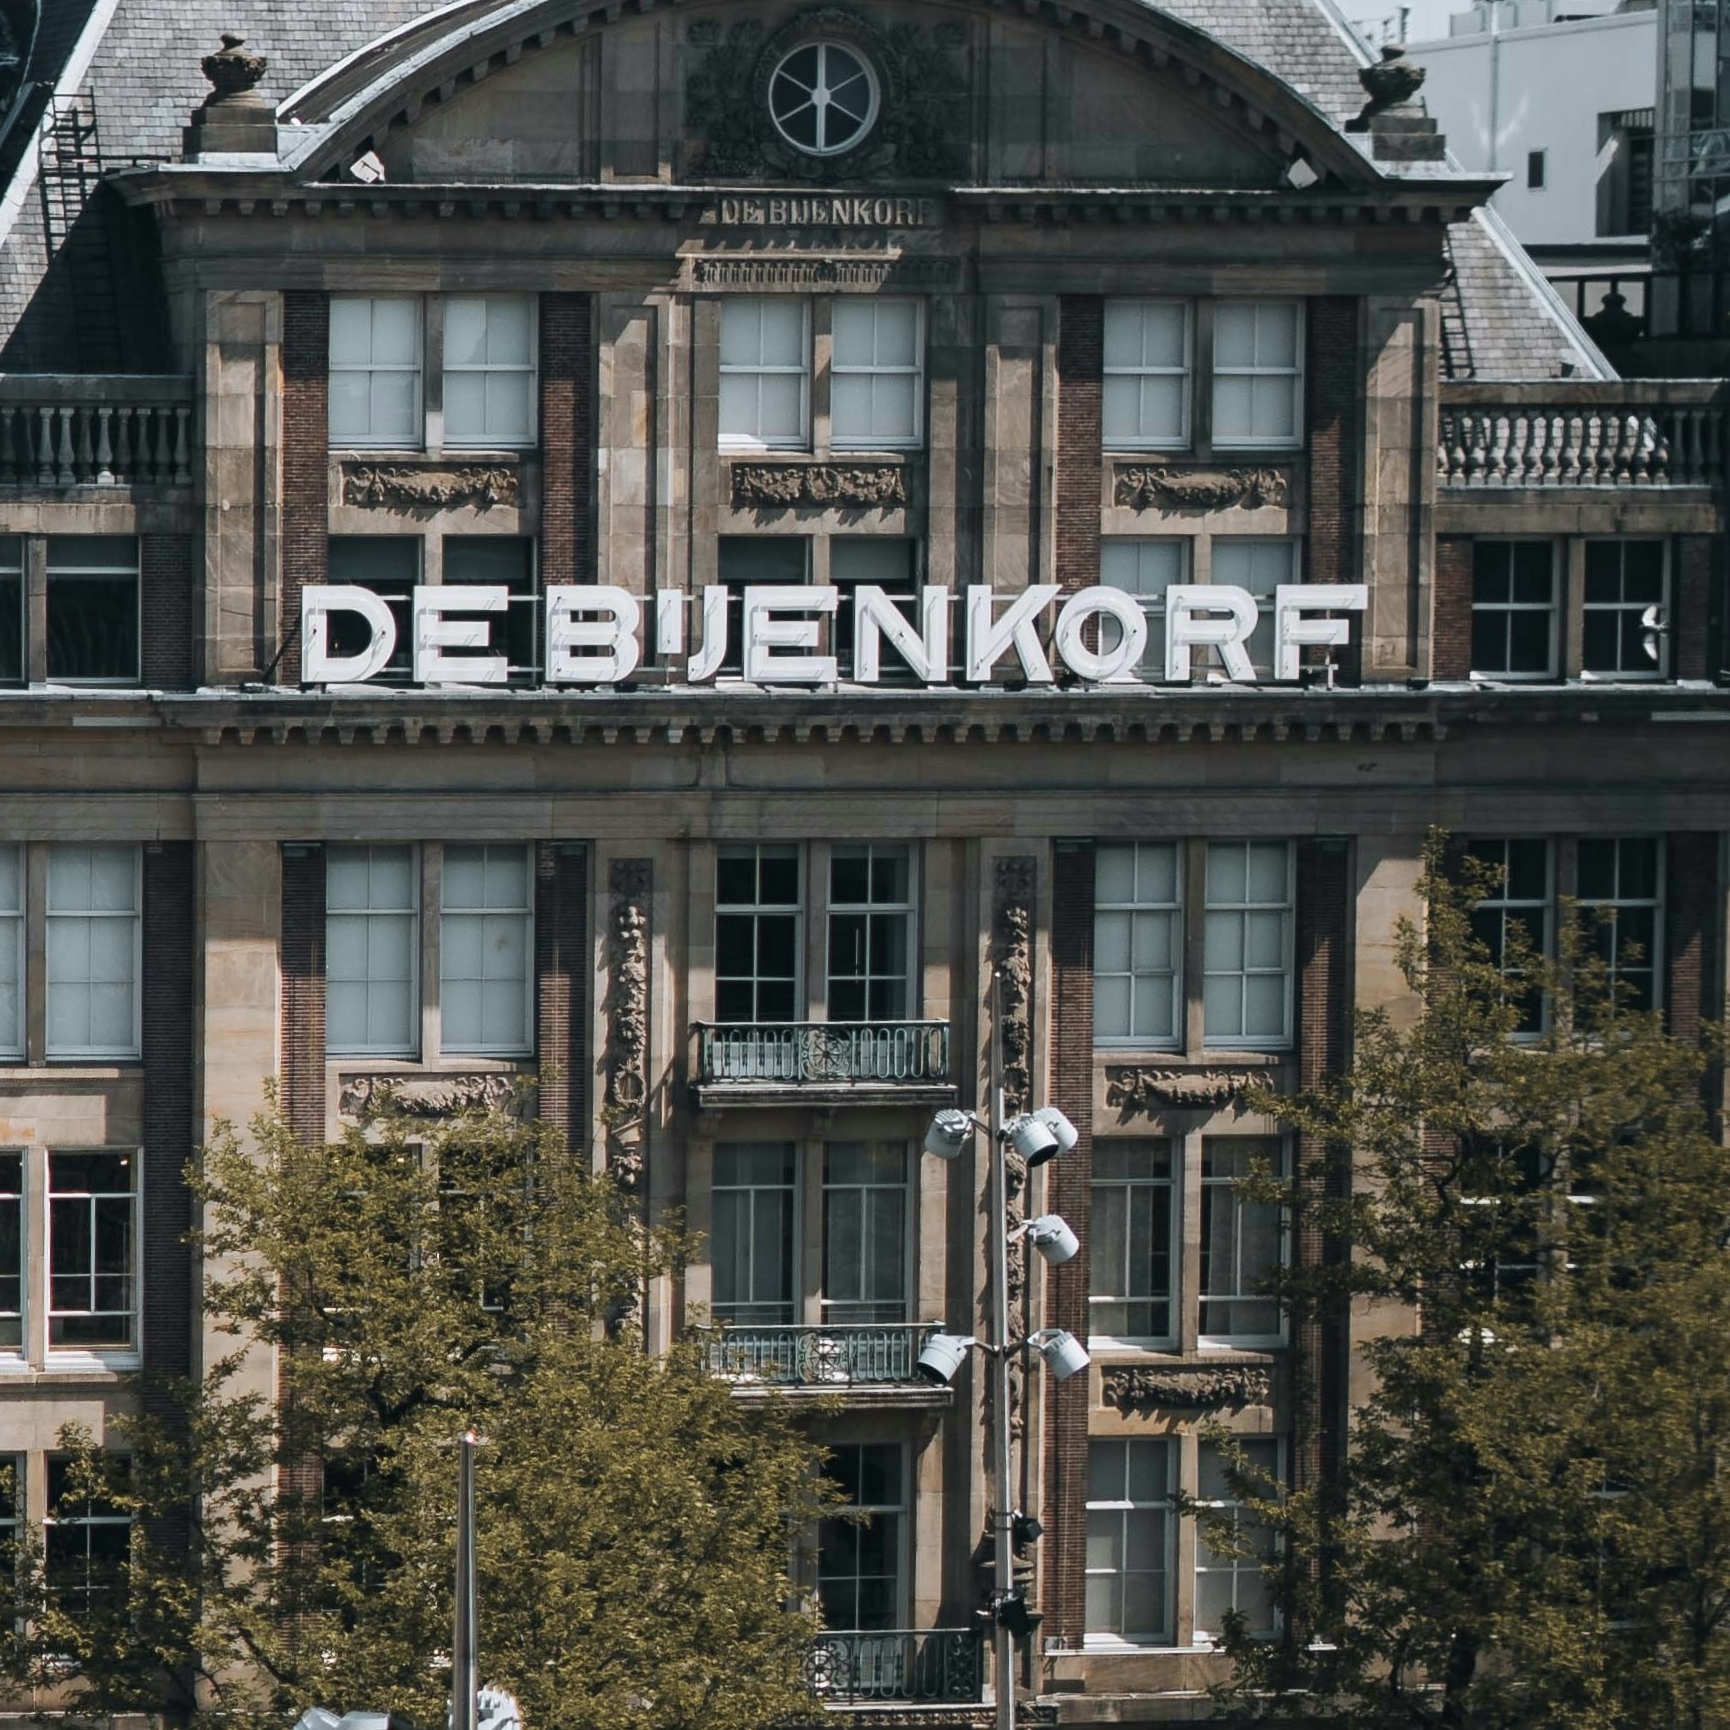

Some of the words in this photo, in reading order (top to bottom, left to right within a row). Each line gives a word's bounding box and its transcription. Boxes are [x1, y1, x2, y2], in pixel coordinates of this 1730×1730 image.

[722, 198, 765, 225] DE
[301, 585, 509, 683] DE
[545, 583, 1369, 683] BIJENKORF
